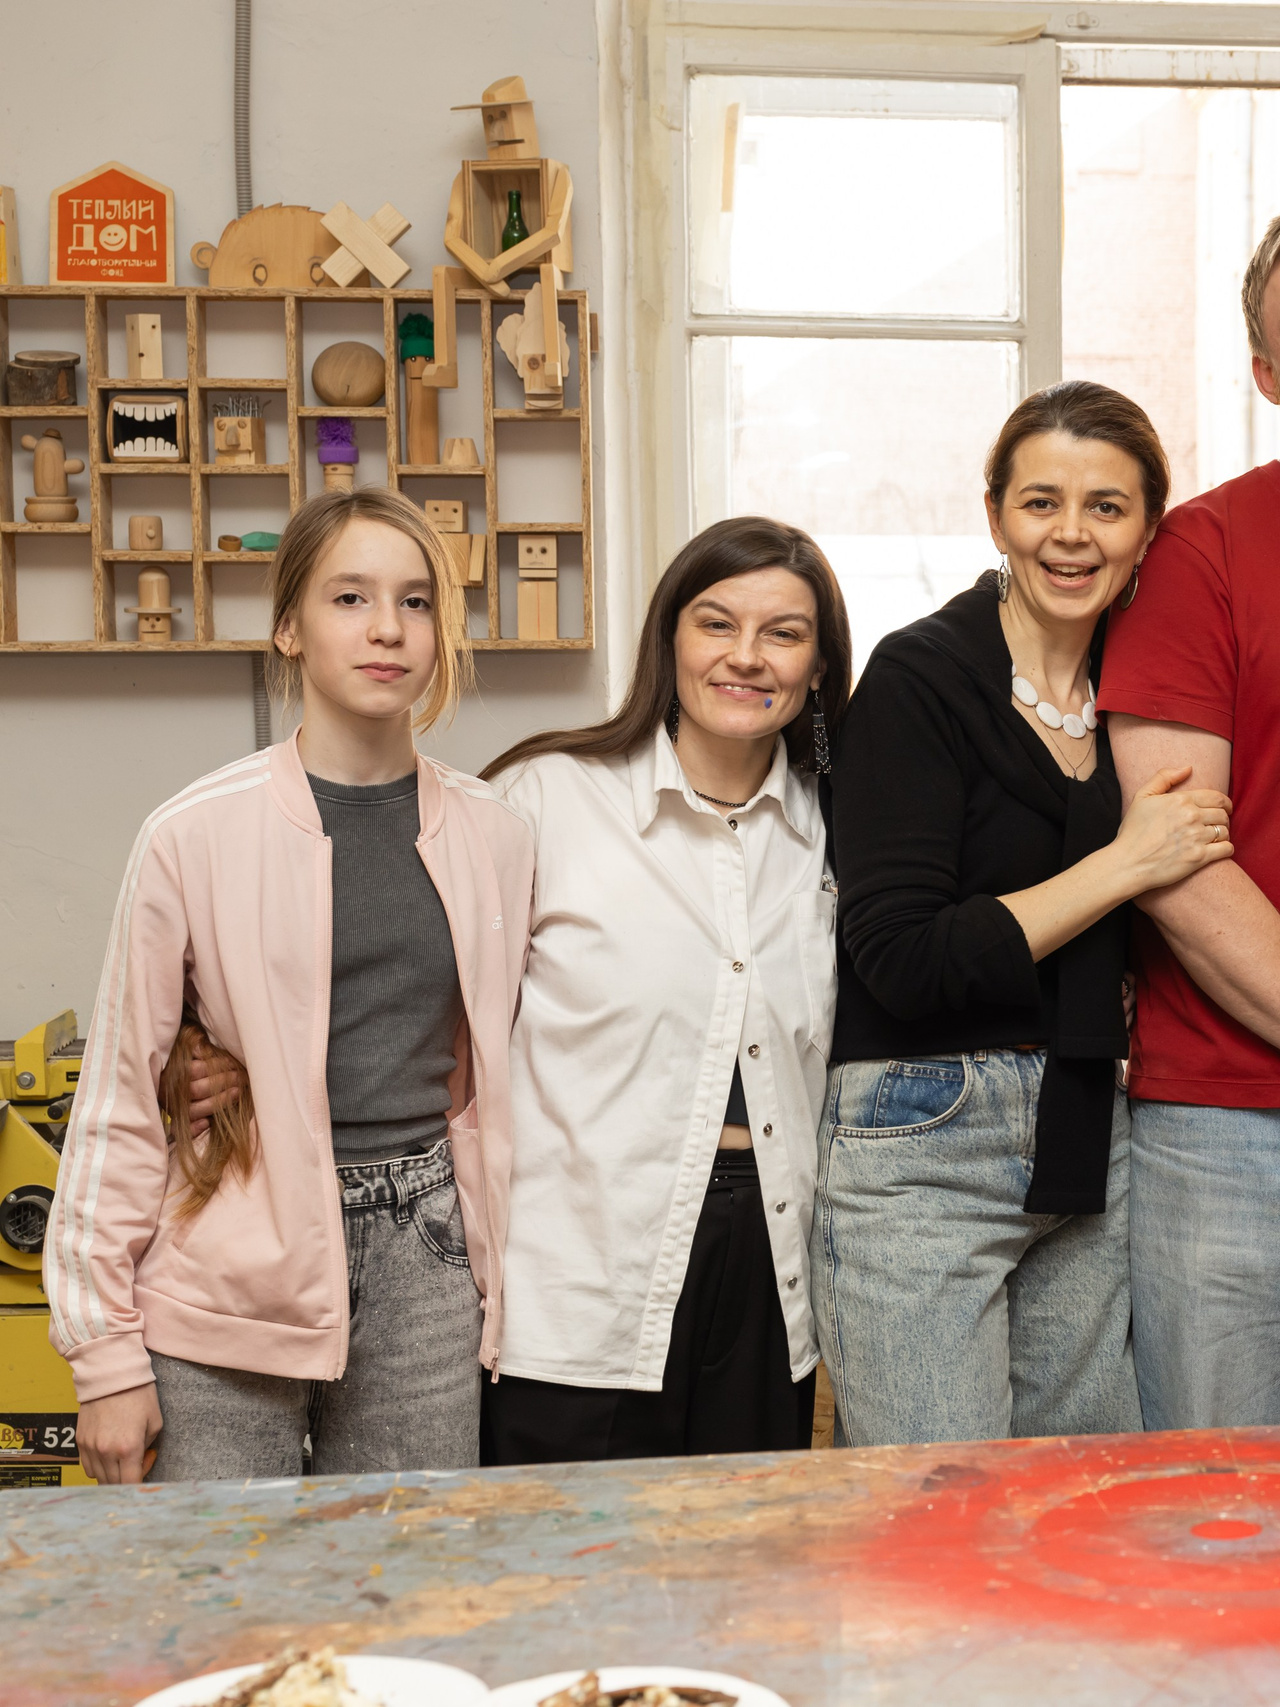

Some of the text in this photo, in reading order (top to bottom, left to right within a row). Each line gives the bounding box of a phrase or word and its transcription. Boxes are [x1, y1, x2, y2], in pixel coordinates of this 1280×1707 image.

[68, 198, 155, 220] ТЕПЛЫЙ
[67, 223, 157, 255] ДОМ
[43, 1426, 76, 1448] 52
